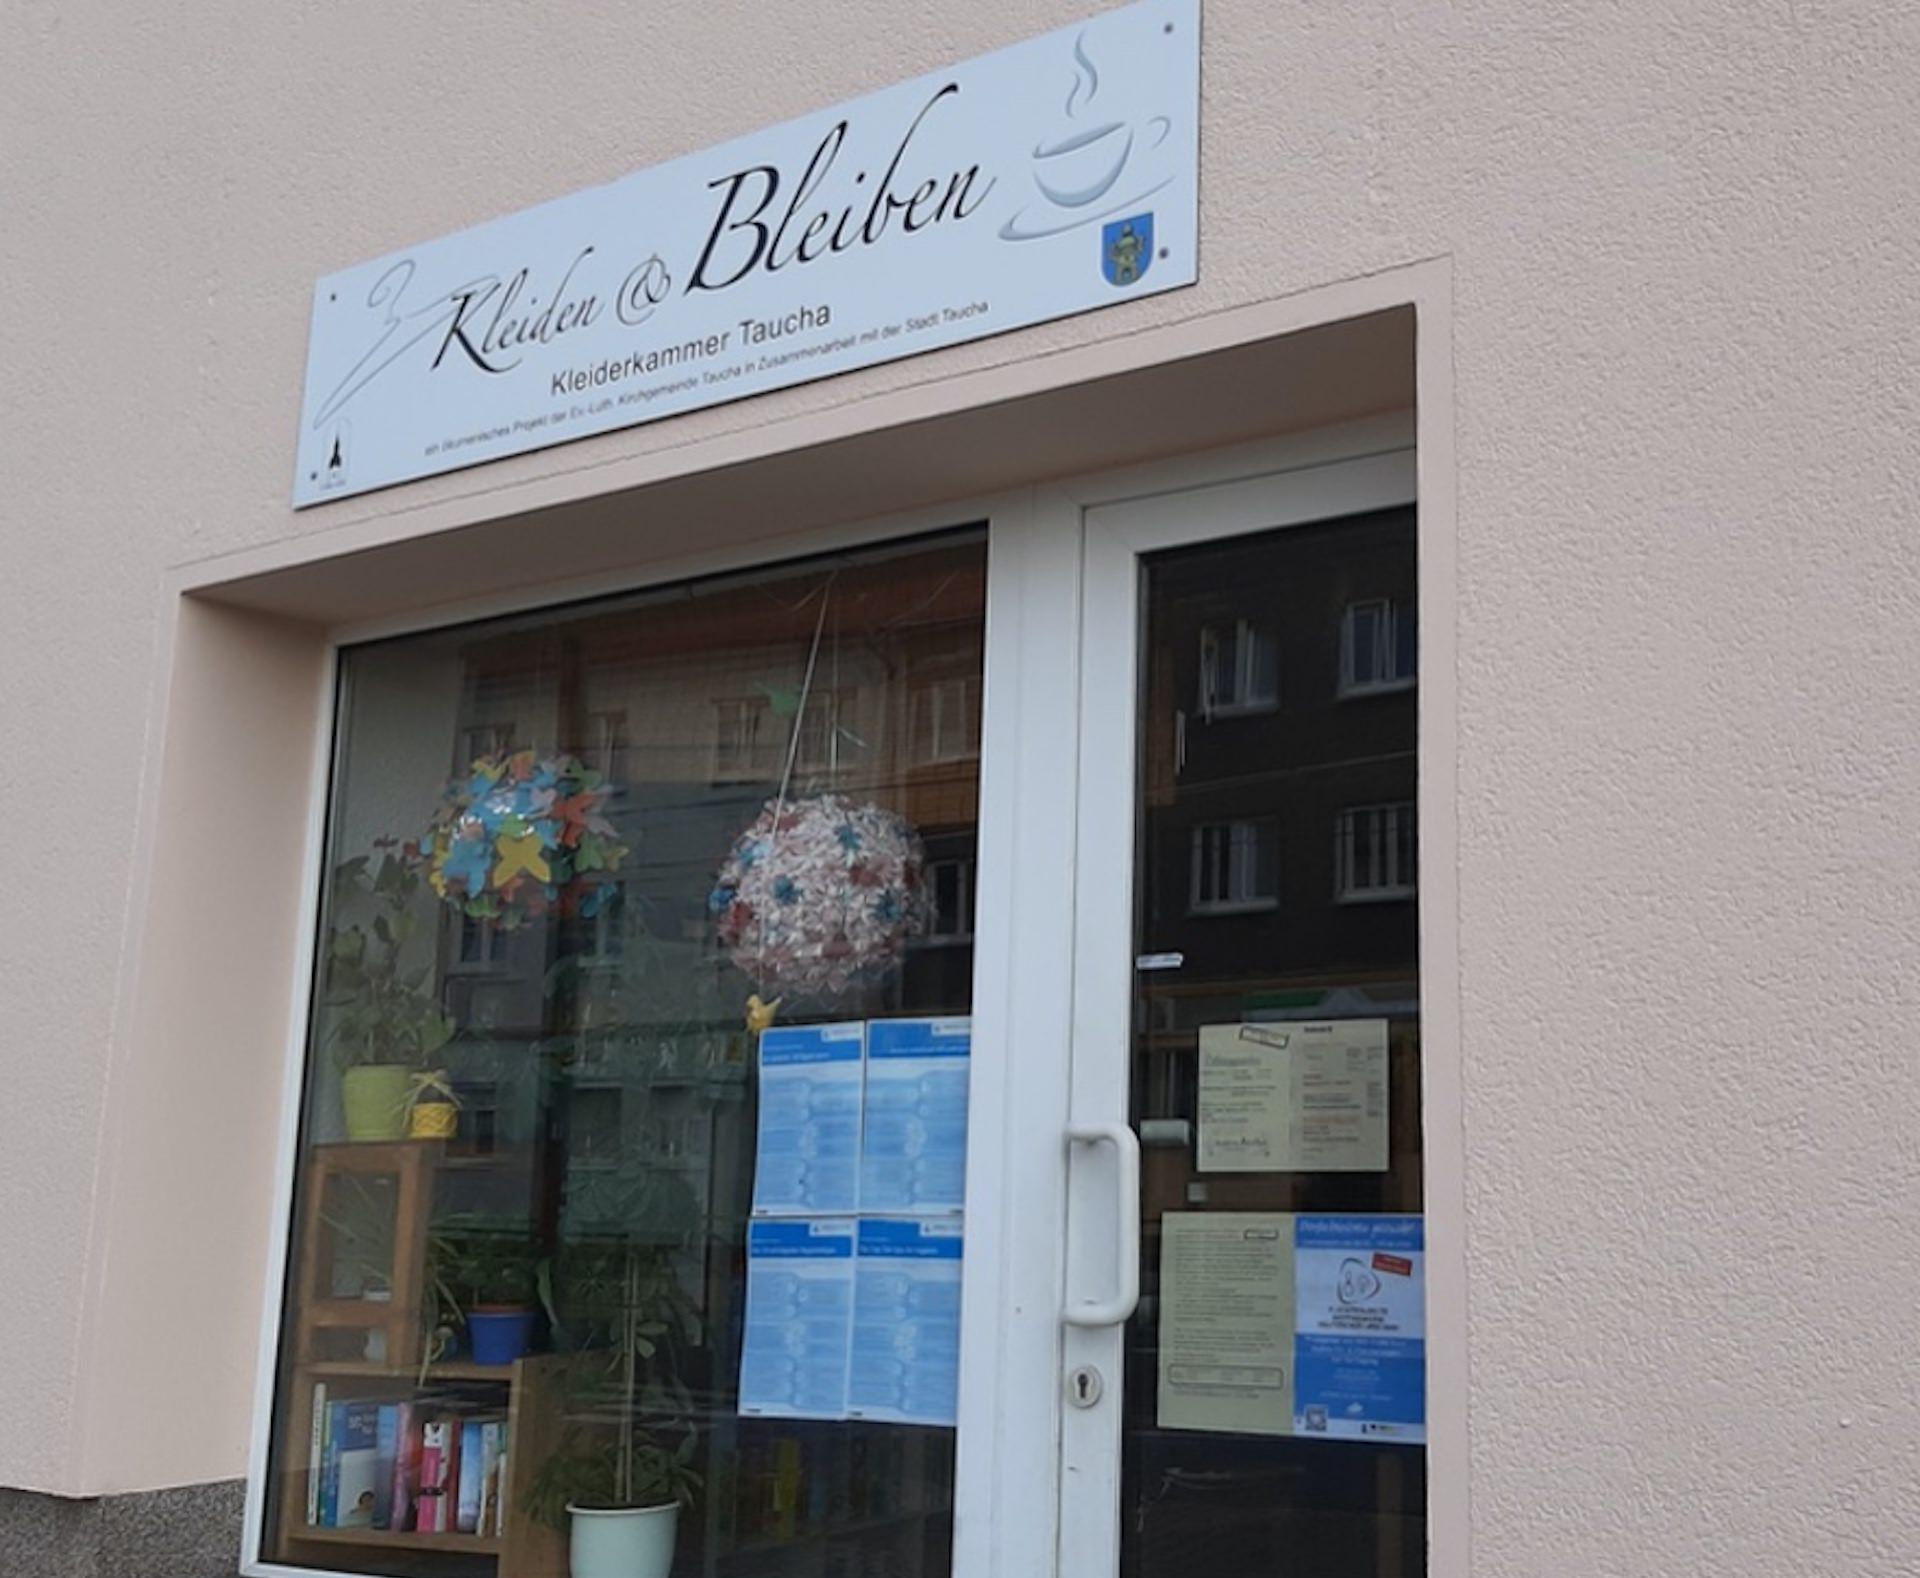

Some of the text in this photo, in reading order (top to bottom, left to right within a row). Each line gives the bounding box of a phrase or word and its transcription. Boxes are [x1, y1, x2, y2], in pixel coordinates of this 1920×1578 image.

[431, 83, 996, 374] Kleiden & Bleiben
[513, 414, 548, 433] Projekt
[551, 411, 567, 425] der
[618, 376, 699, 404] Kirchgemeinde
[703, 366, 742, 385] Taucha
[745, 359, 756, 373] in
[758, 335, 857, 370] Zusammenarbeit
[859, 327, 880, 345] mit
[881, 324, 901, 340] der
[904, 313, 940, 333] Stadt
[942, 301, 990, 322] Taucha
[550, 304, 831, 396] Kleiderkammer Taucha
